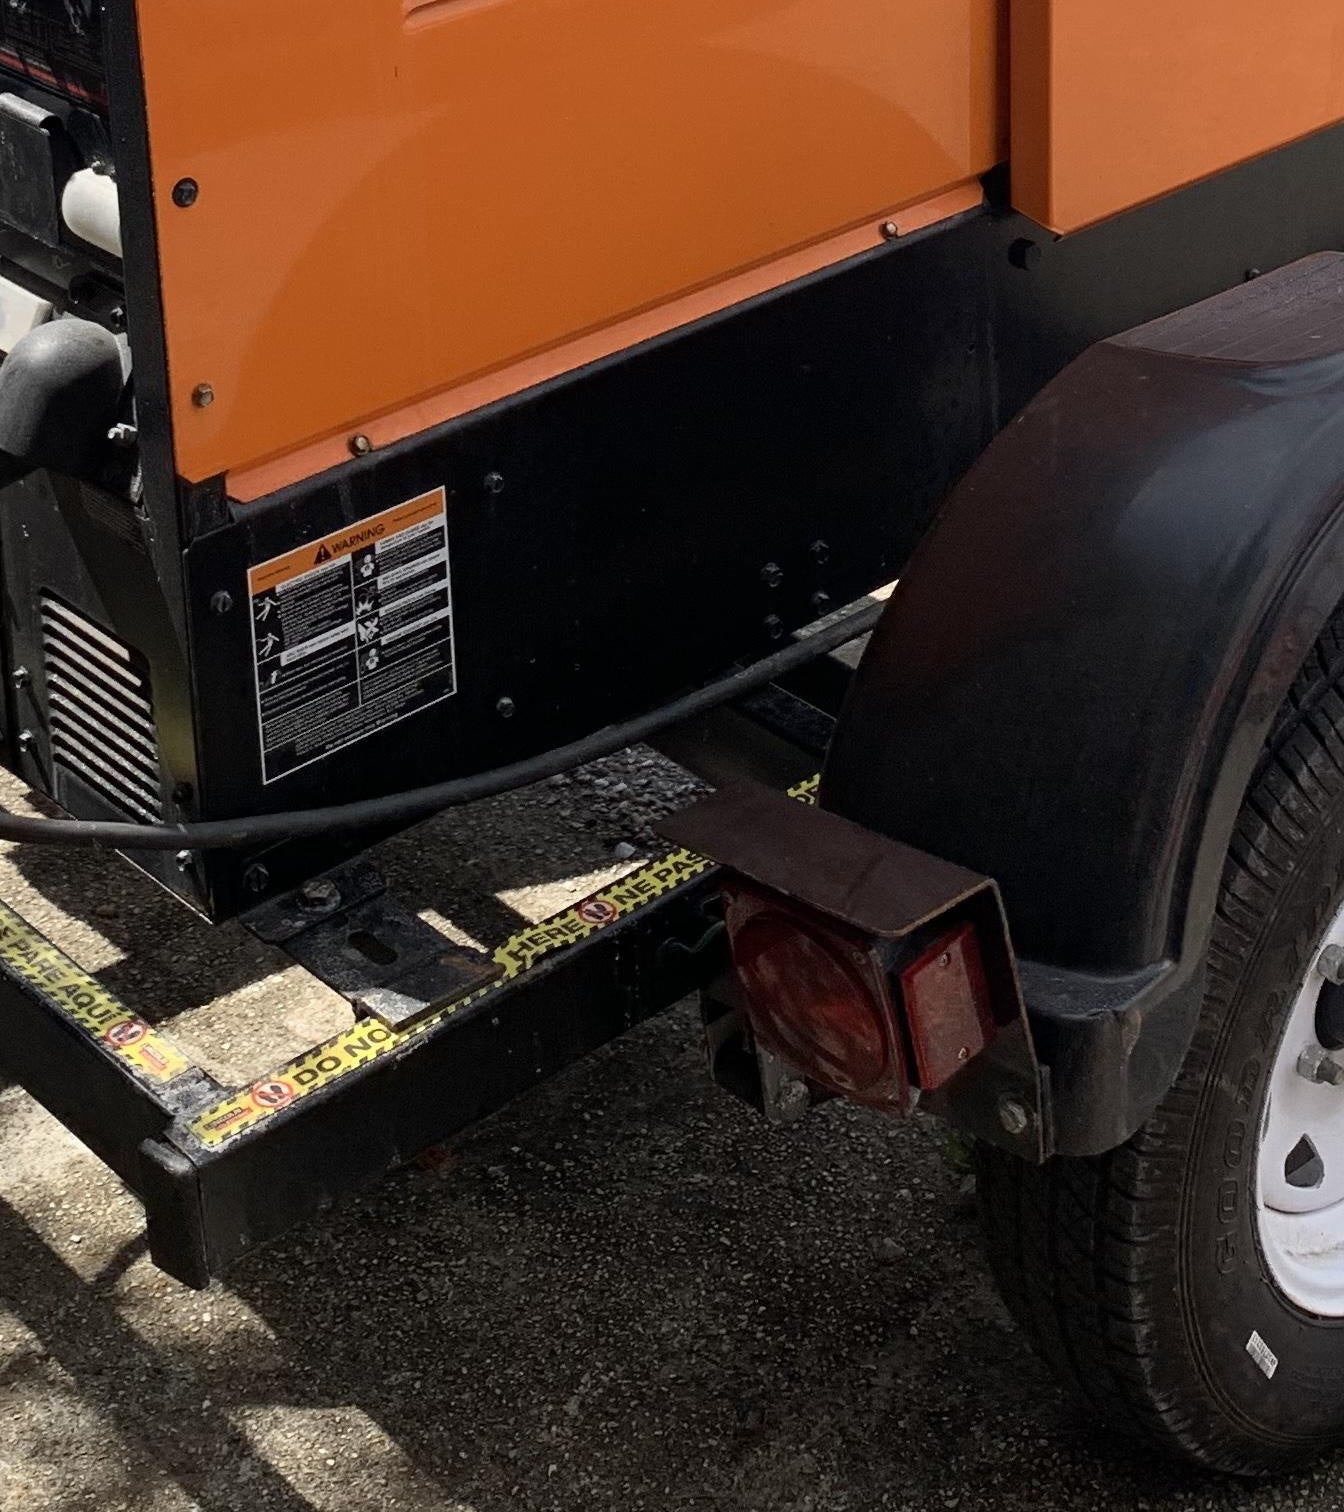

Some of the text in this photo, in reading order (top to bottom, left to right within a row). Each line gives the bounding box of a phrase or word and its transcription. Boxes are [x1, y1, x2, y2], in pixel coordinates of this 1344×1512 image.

[331, 523, 386, 554] WARNING
[613, 880, 652, 906] NE
[7, 937, 66, 983] PARE
[291, 917, 587, 1088] DO NO HERE
